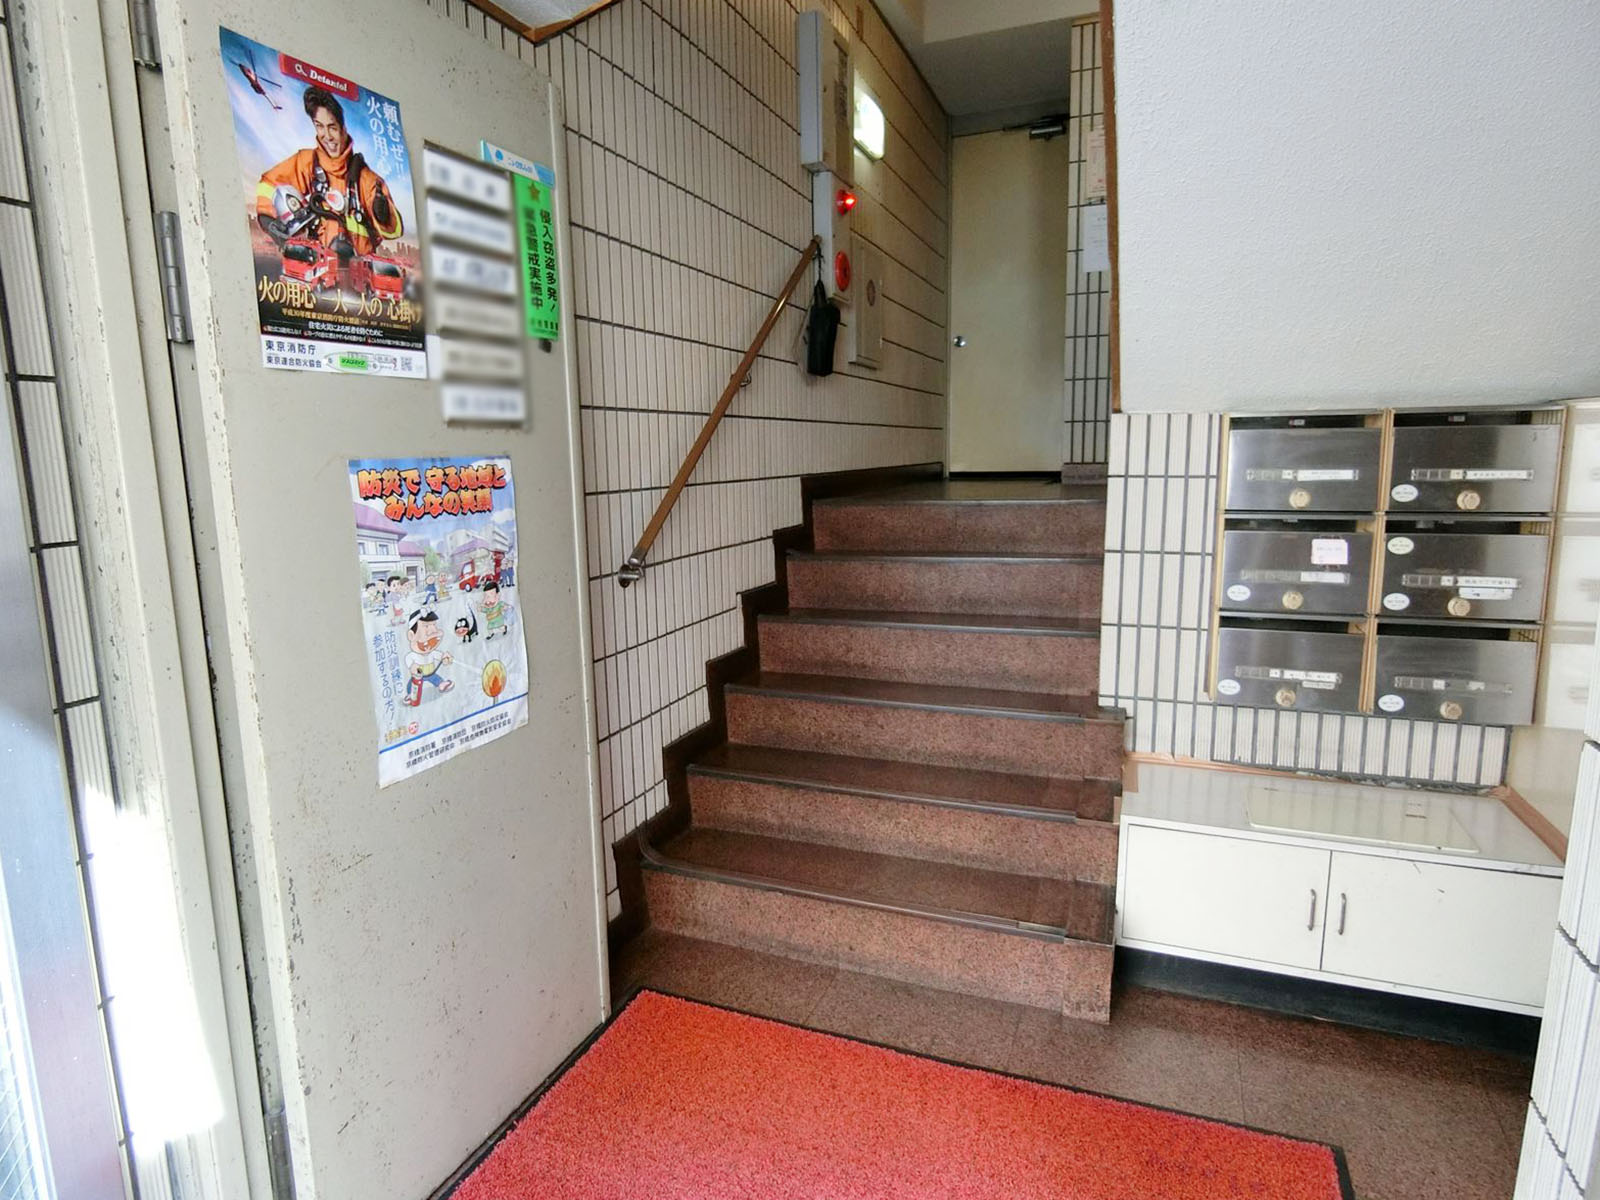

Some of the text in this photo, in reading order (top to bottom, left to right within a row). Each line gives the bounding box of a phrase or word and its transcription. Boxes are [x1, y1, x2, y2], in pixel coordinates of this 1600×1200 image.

[366, 96, 392, 176] 火の用心
[258, 275, 317, 309] 火の用心
[265, 339, 317, 356] 東京消防庁
